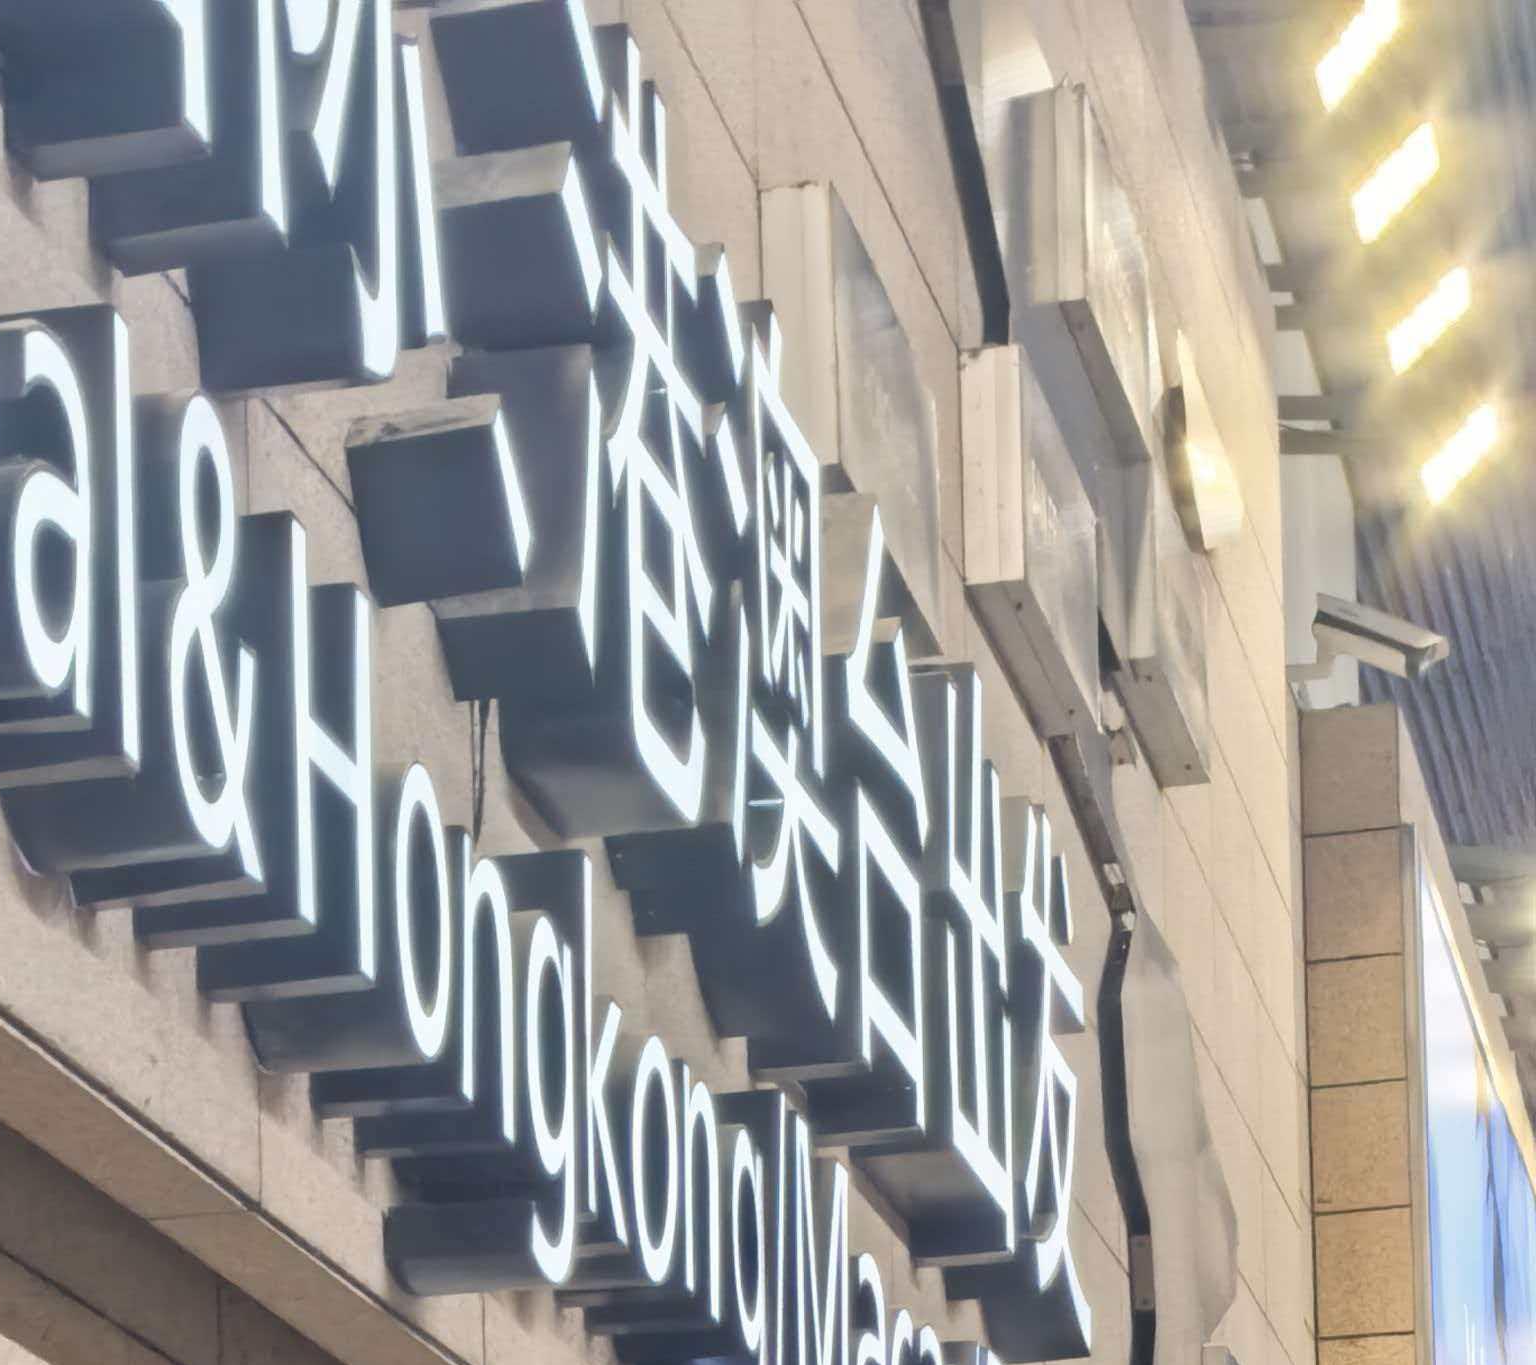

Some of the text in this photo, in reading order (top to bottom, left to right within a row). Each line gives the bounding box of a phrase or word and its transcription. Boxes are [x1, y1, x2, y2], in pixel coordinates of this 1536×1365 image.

[169, 394, 262, 882] &
[178, 0, 1092, 1357] 、港澳台出发
